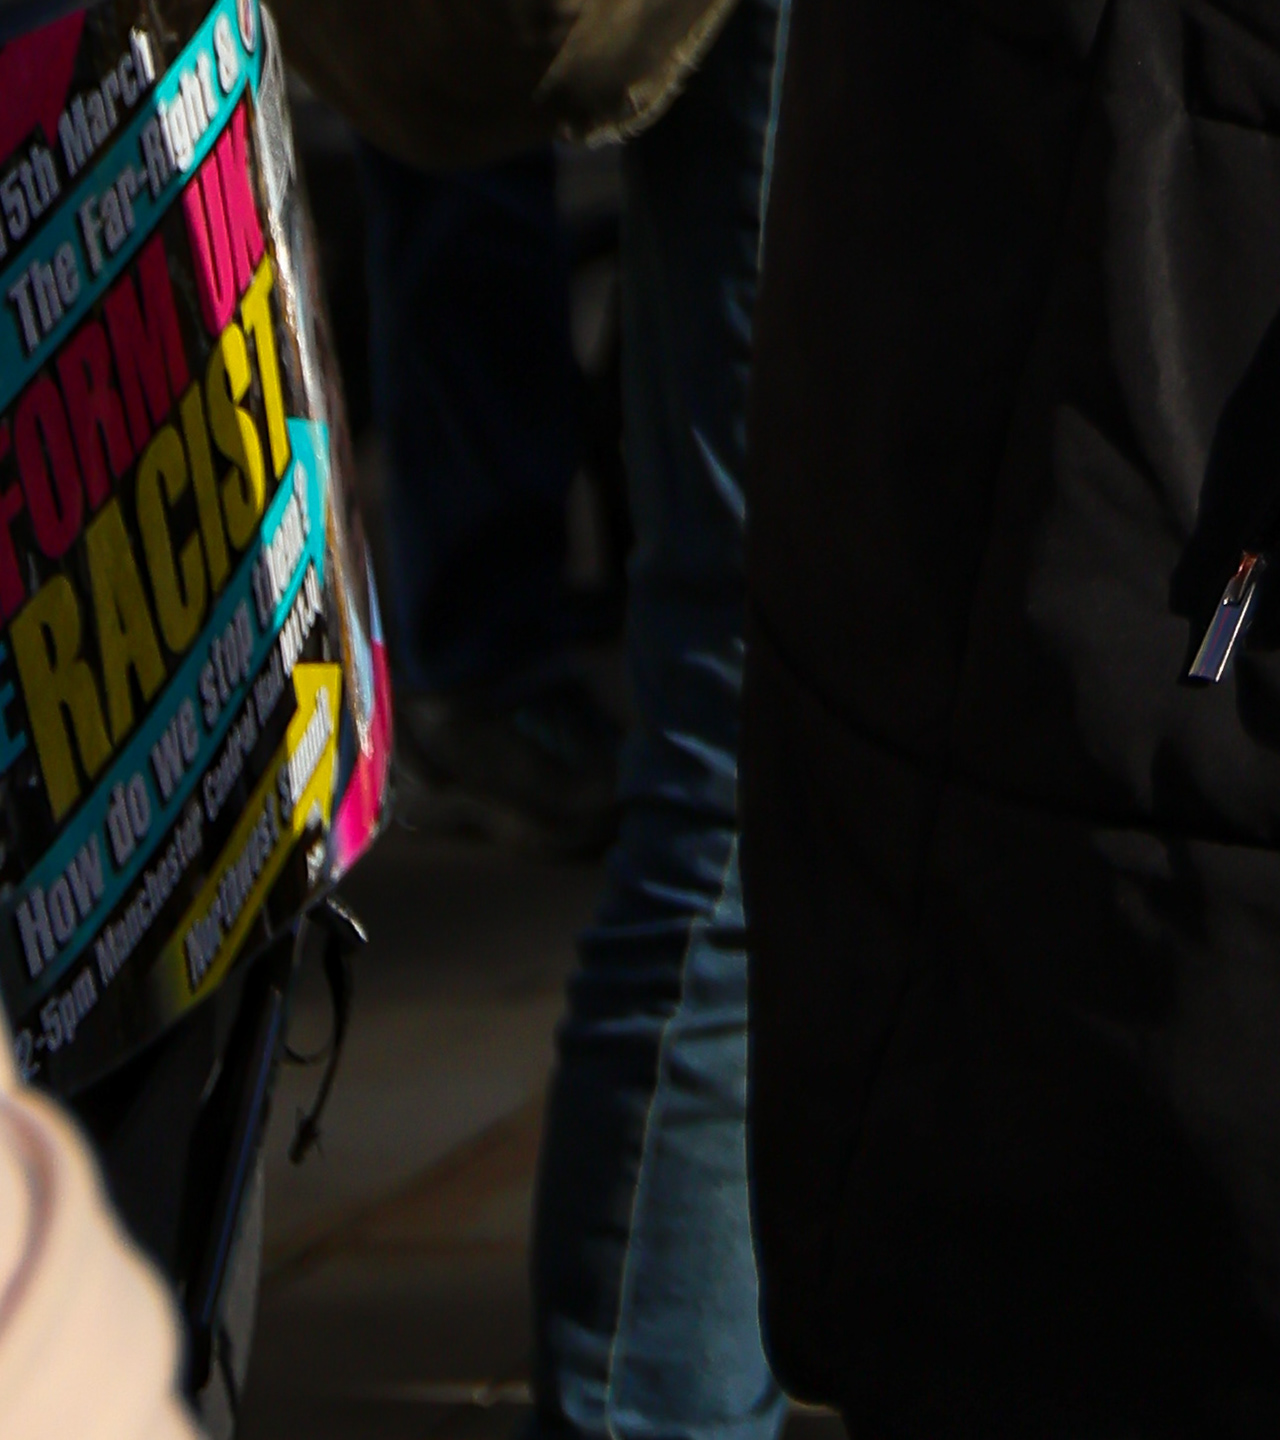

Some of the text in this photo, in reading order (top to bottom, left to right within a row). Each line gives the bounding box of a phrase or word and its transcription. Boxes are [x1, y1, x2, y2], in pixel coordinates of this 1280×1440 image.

[0, 27, 156, 257] 5th March
[7, 240, 80, 357] The
[77, 48, 220, 279] Far-Right
[181, 98, 266, 339] UK
[8, 251, 293, 824] RACIST
[16, 832, 106, 980] How
[106, 771, 152, 869] do
[150, 695, 200, 805] we
[199, 596, 255, 727] stop
[94, 795, 203, 987] Manchester
